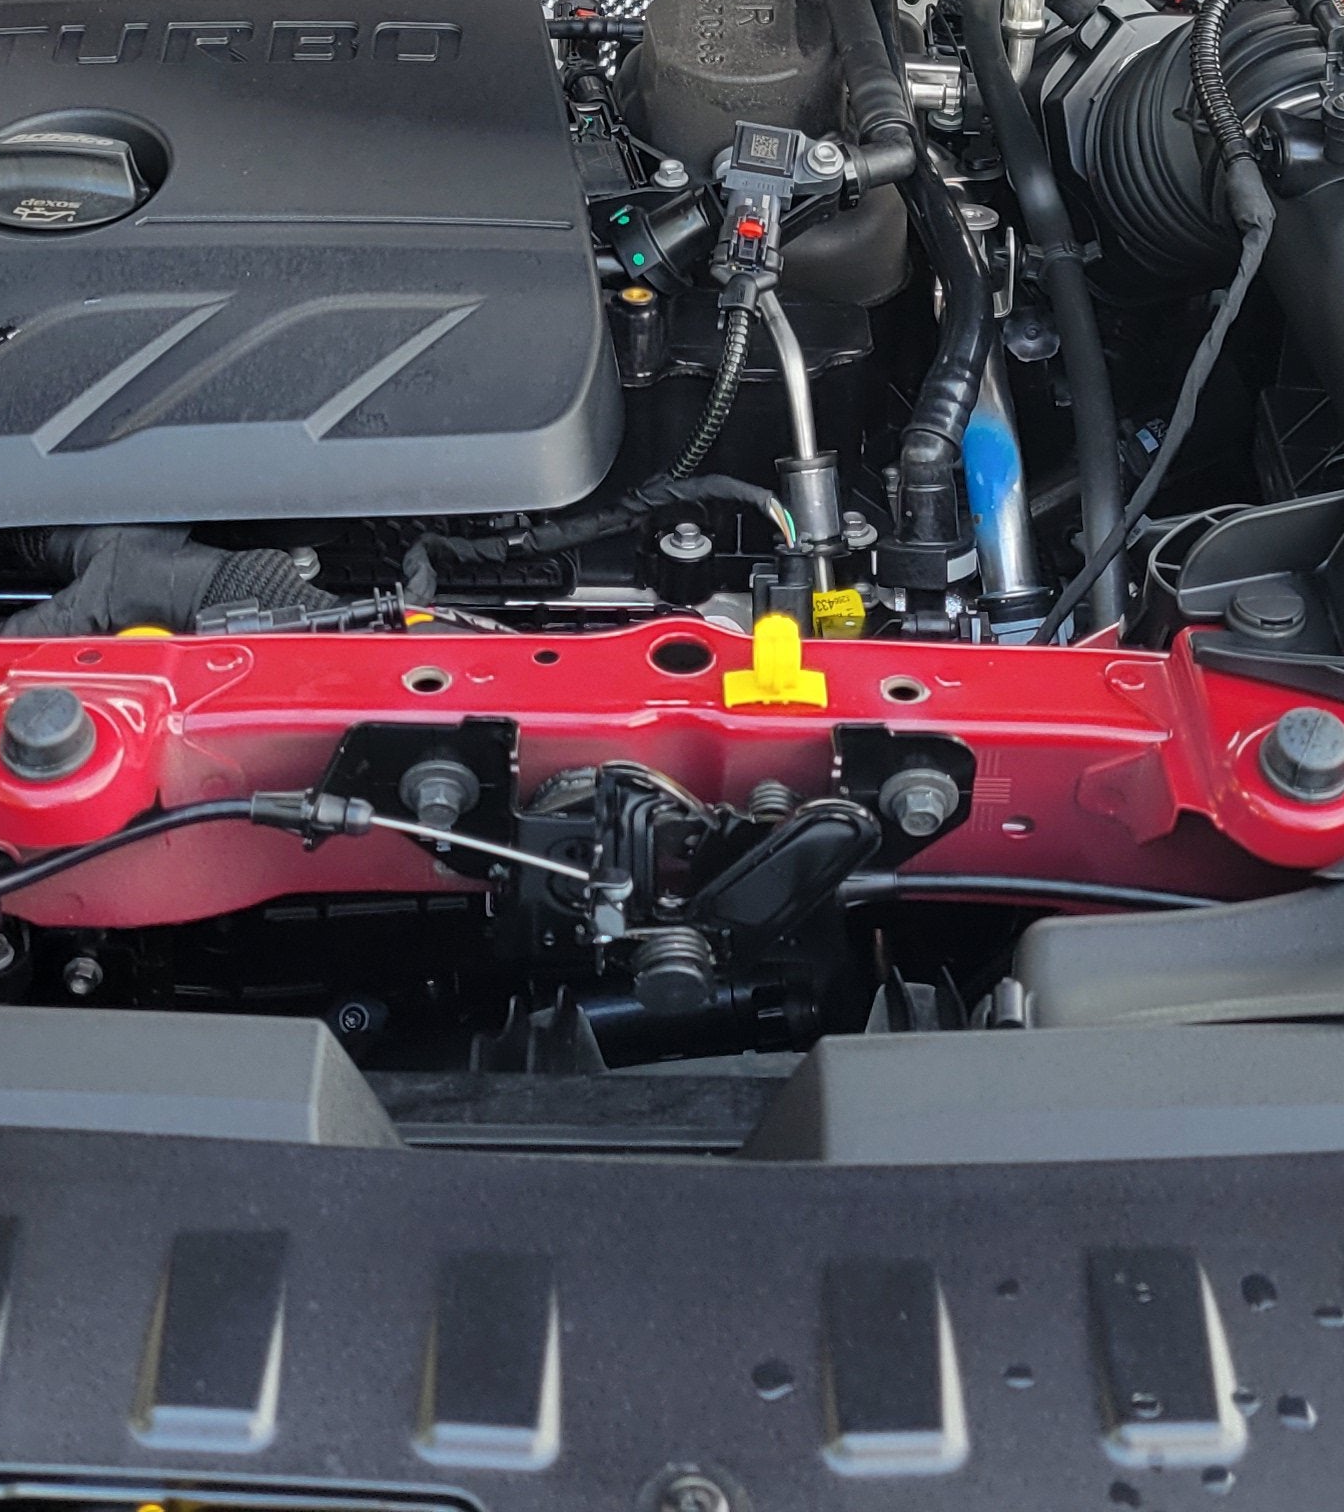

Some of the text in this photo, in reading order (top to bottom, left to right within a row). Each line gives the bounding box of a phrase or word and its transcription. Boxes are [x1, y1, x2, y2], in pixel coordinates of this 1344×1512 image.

[735, 4, 775, 26] R
[1, 133, 114, 146] ACDelco
[21, 198, 82, 209] dexos
